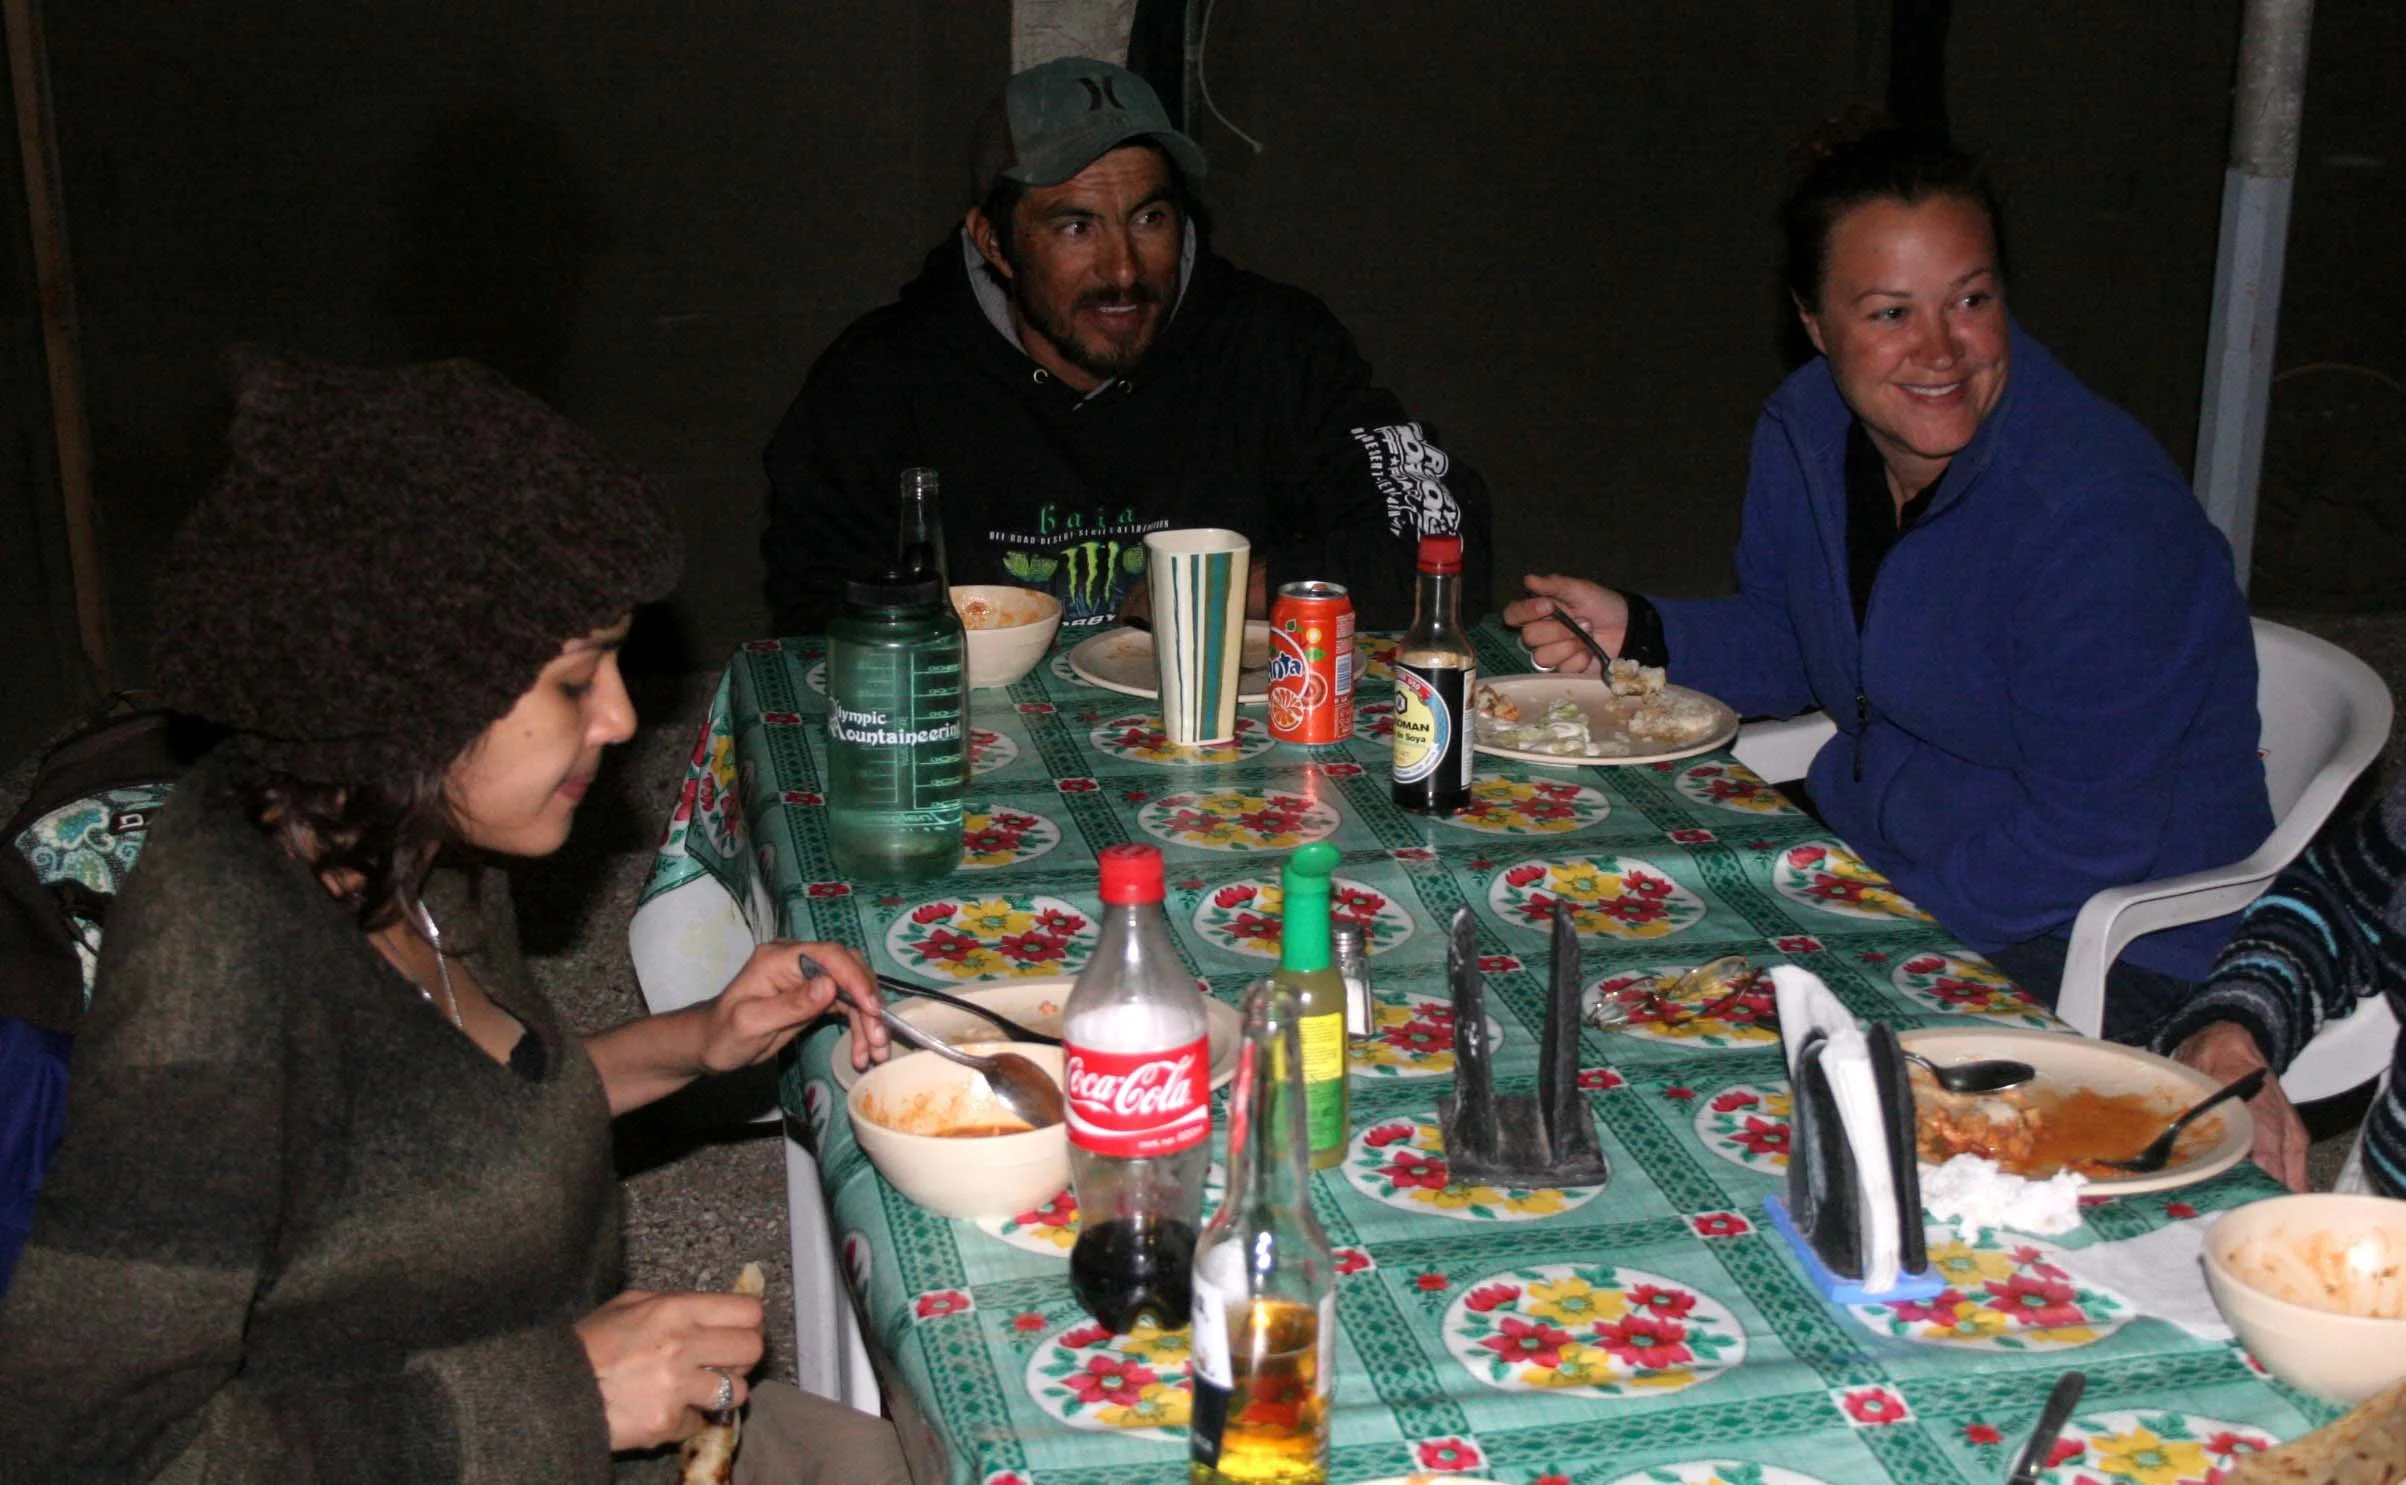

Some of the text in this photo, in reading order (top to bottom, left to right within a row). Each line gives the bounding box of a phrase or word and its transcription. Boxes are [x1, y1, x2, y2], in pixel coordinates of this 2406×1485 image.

[1010, 533, 1037, 545] ROAD
[1268, 651, 1304, 681] nta
[1395, 718, 1430, 732] OMAN
[1405, 732, 1426, 744] Soya
[1065, 1054, 1196, 1117] Coca-Cola
